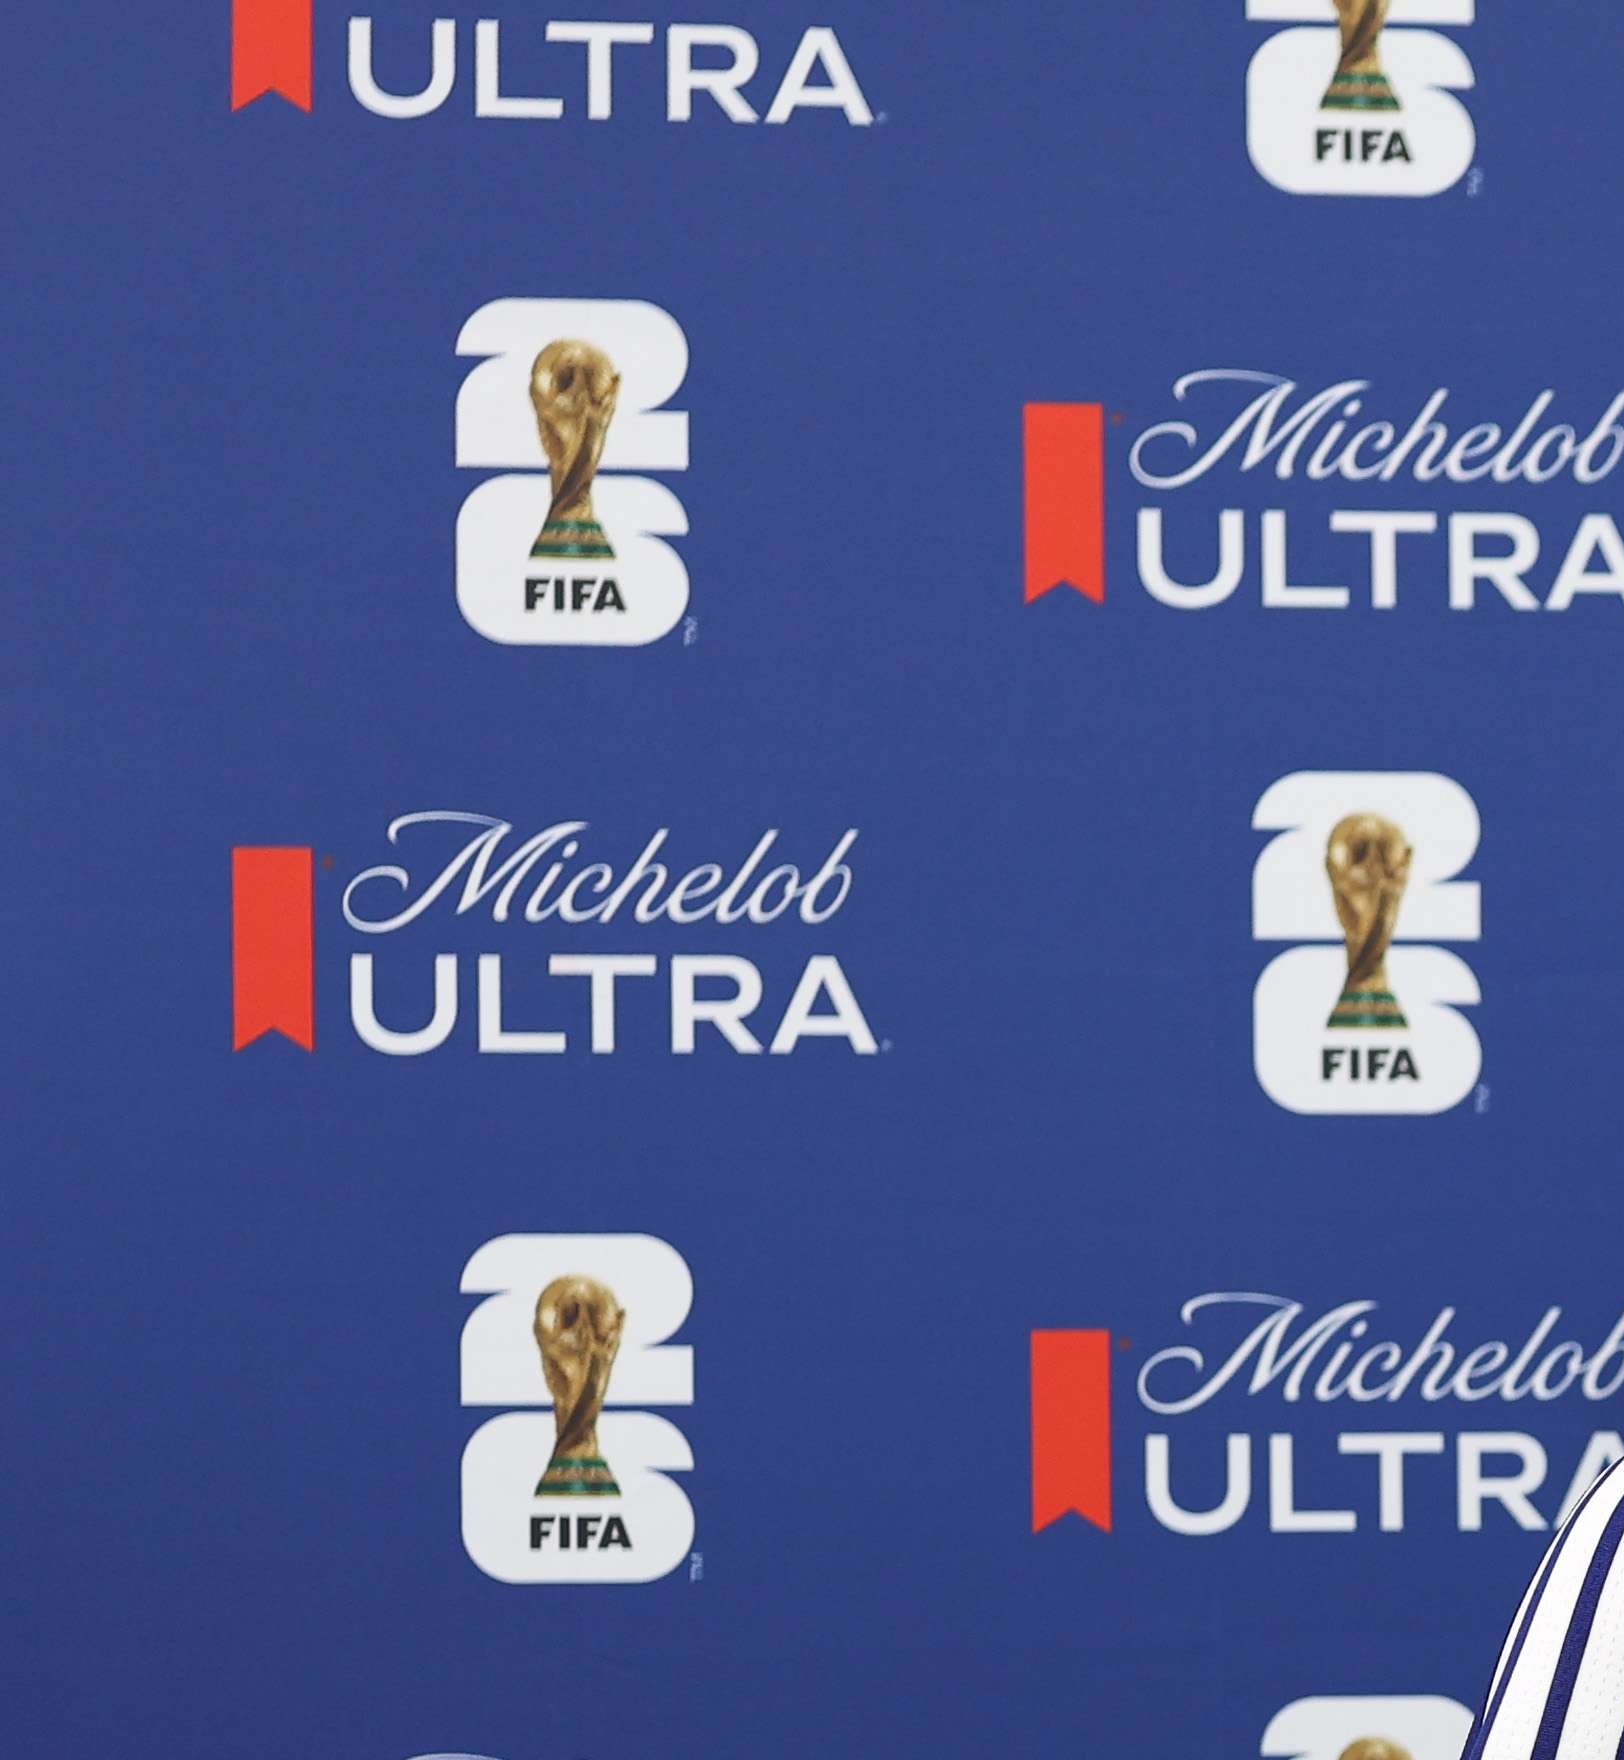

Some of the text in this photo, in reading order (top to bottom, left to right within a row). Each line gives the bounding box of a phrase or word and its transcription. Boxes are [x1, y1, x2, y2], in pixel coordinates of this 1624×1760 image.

[348, 16, 874, 126] ULTRA
[1315, 128, 1412, 163] FIFA
[524, 577, 627, 613] FIFA
[342, 811, 858, 933] Michelob
[350, 953, 878, 1056] ULTRA
[1322, 1048, 1420, 1081] FIFA
[529, 1515, 633, 1550] FIFA
